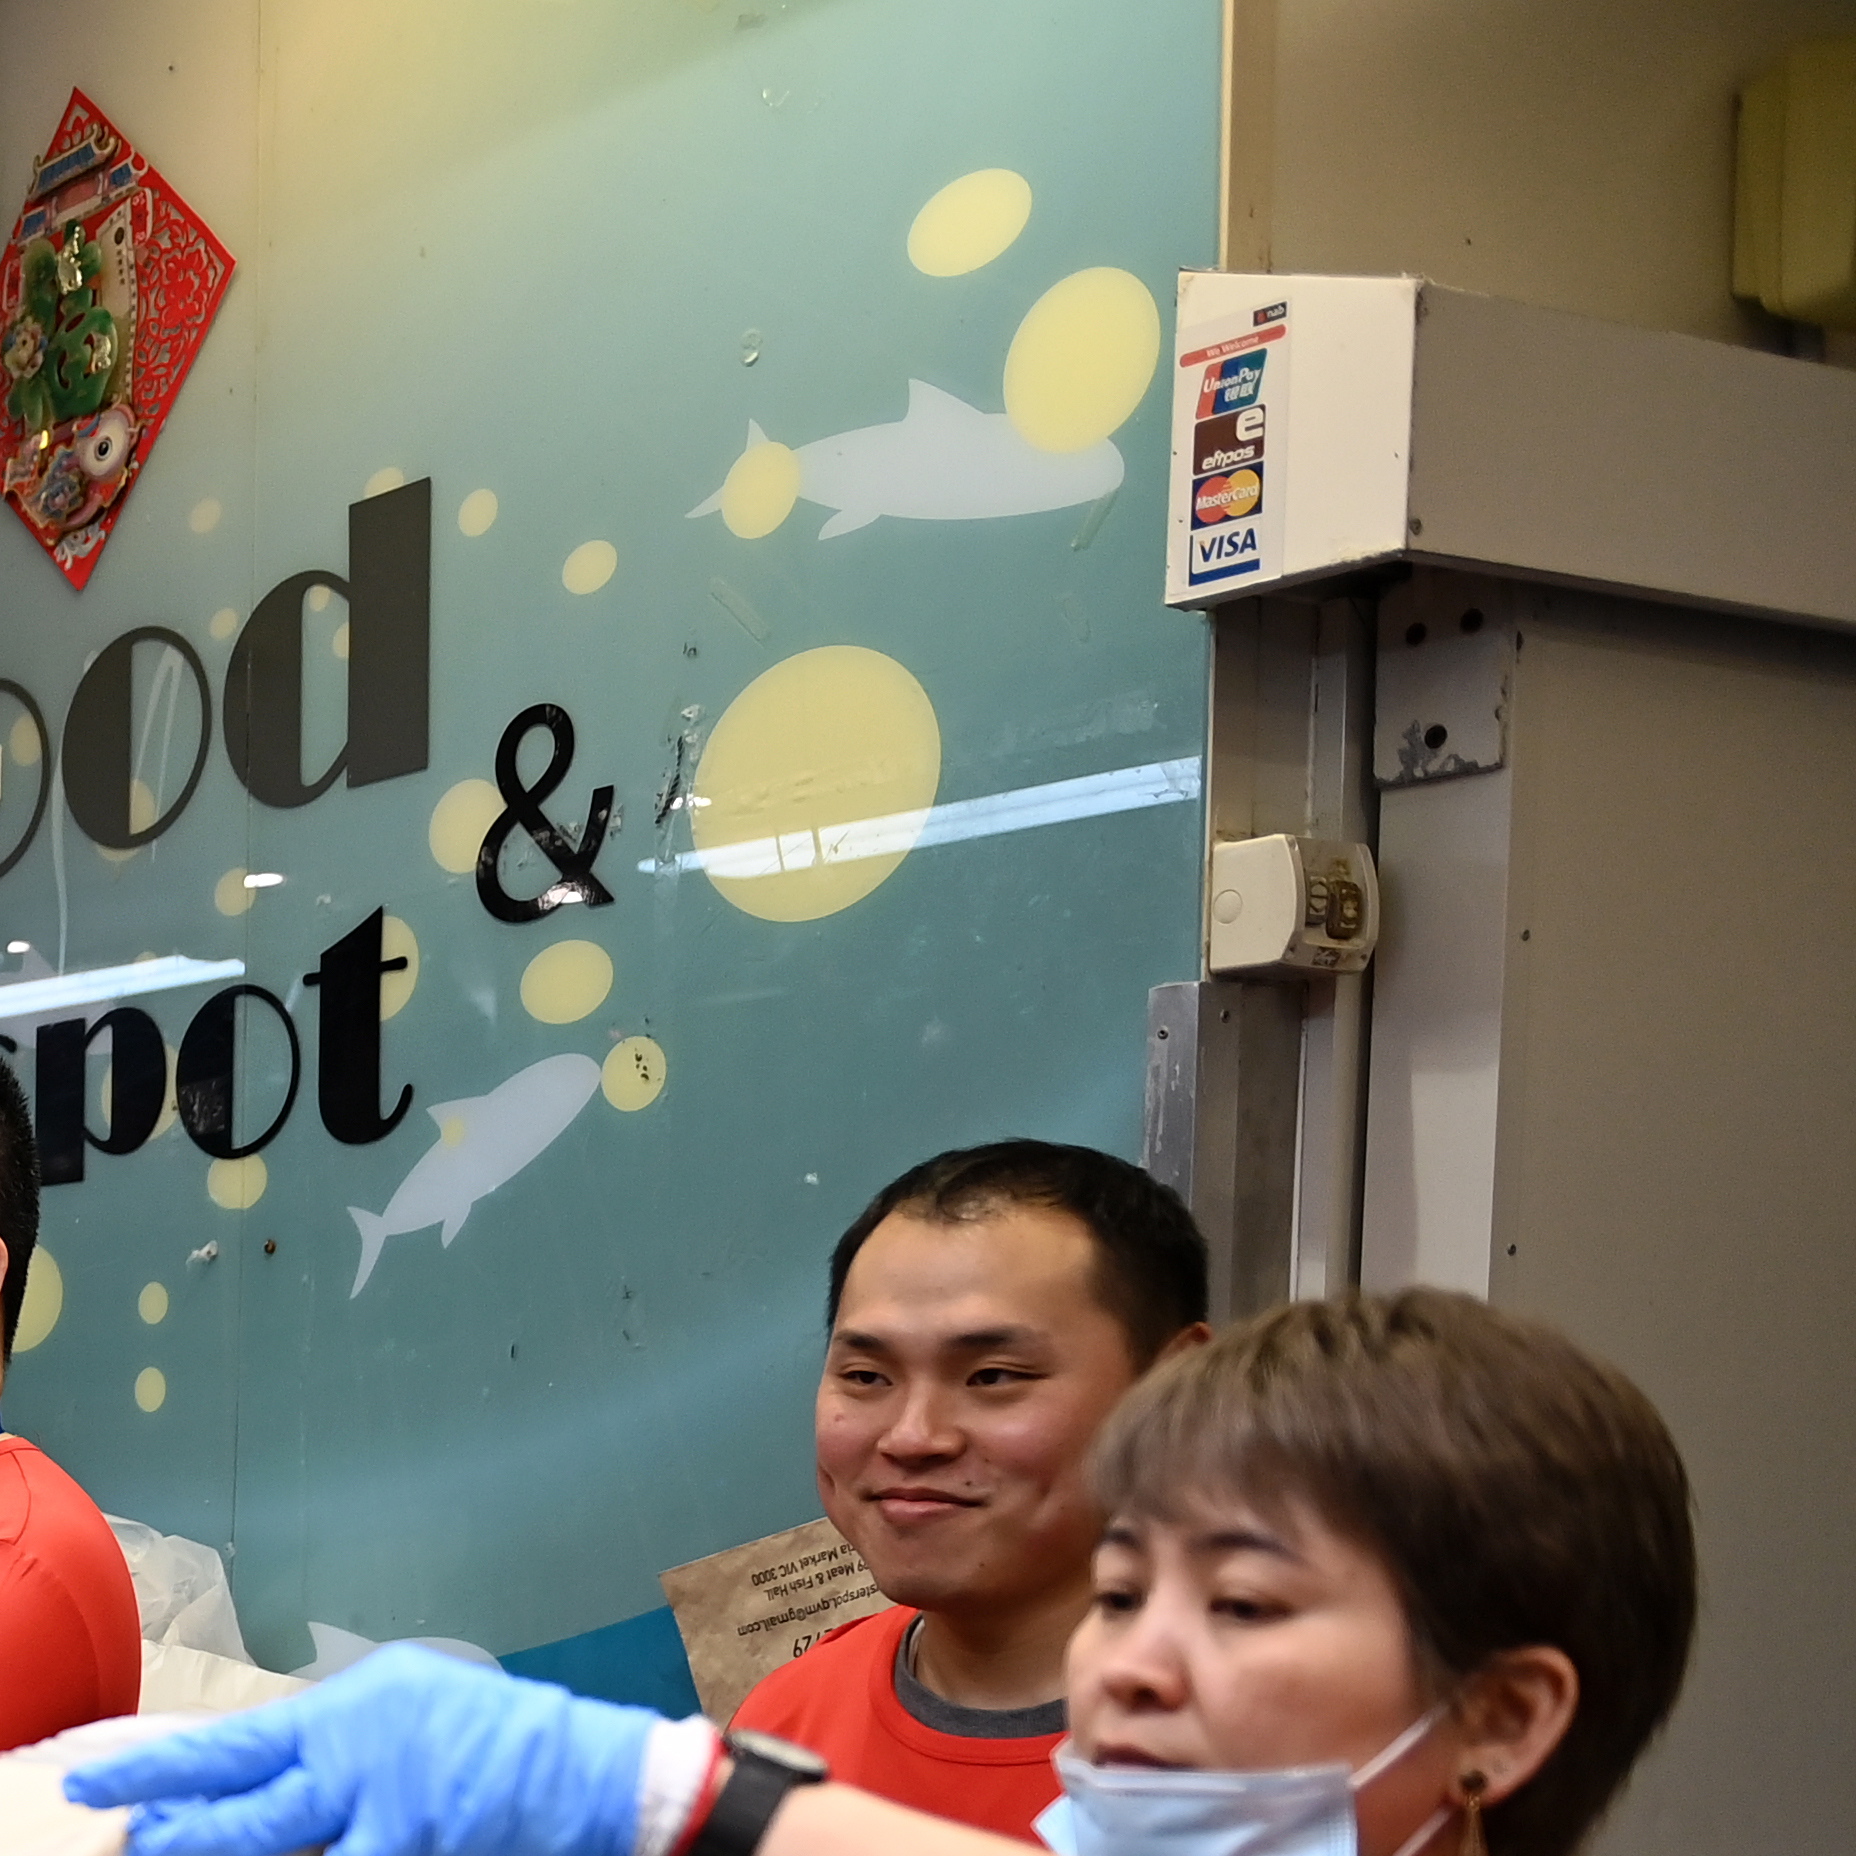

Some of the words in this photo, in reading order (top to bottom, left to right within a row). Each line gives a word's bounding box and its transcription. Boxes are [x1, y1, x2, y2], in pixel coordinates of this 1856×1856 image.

[1205, 346, 1221, 358] We
[1221, 335, 1260, 353] Welcome
[1203, 366, 1262, 393] UnionPay
[1236, 407, 1264, 441] e
[1202, 444, 1255, 470] eftpos
[1196, 484, 1260, 511] MasterCard
[1199, 527, 1258, 563] VISA
[475, 701, 616, 924] &
[778, 1561, 799, 1578] VIC
[798, 1549, 838, 1571] Market
[751, 1570, 778, 1587] 3000
[815, 1572, 825, 1585] &
[828, 1563, 855, 1581] Meat
[764, 1584, 789, 1601] Hall
[790, 1578, 814, 1593] Fish
[737, 1584, 880, 1637] sterspot.qvm@gmail.com
